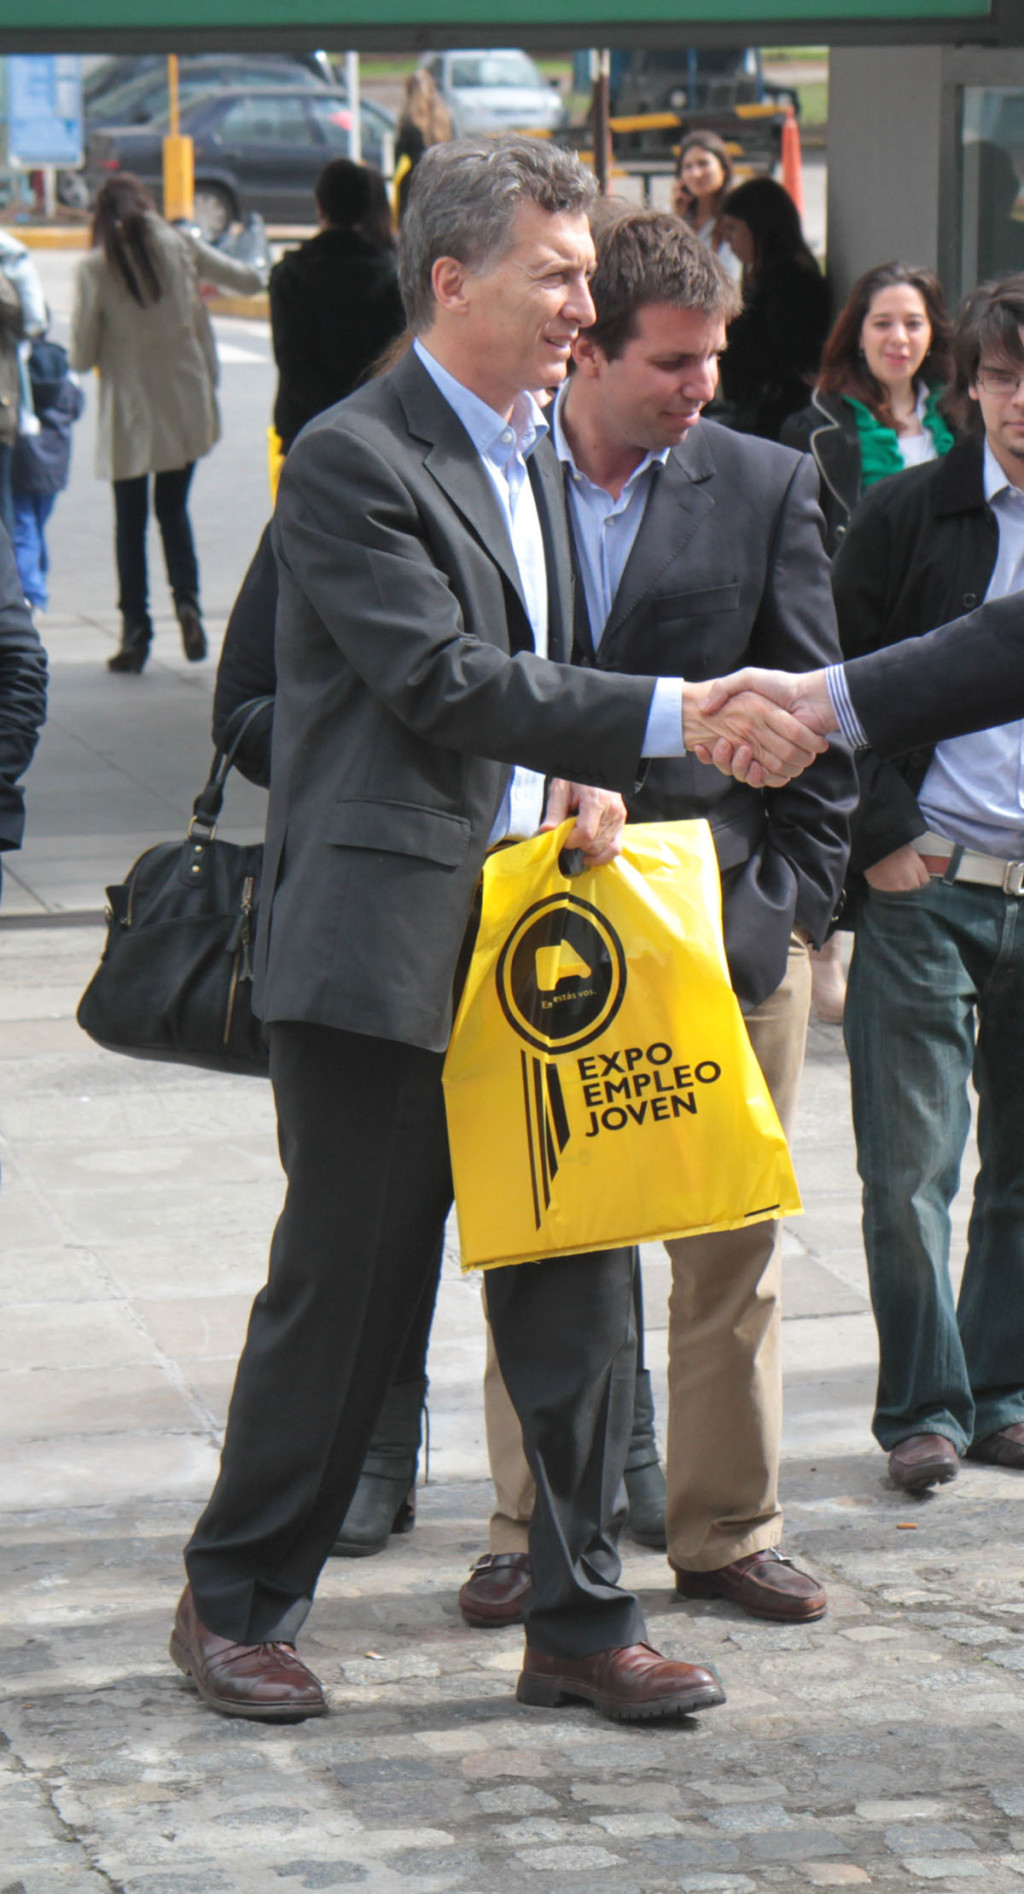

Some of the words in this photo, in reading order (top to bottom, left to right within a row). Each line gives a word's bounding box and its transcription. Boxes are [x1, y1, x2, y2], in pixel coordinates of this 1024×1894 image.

[577, 1042, 673, 1081] EXPO
[583, 1061, 721, 1108] EMPLEO
[585, 1092, 697, 1138] JOVEN
